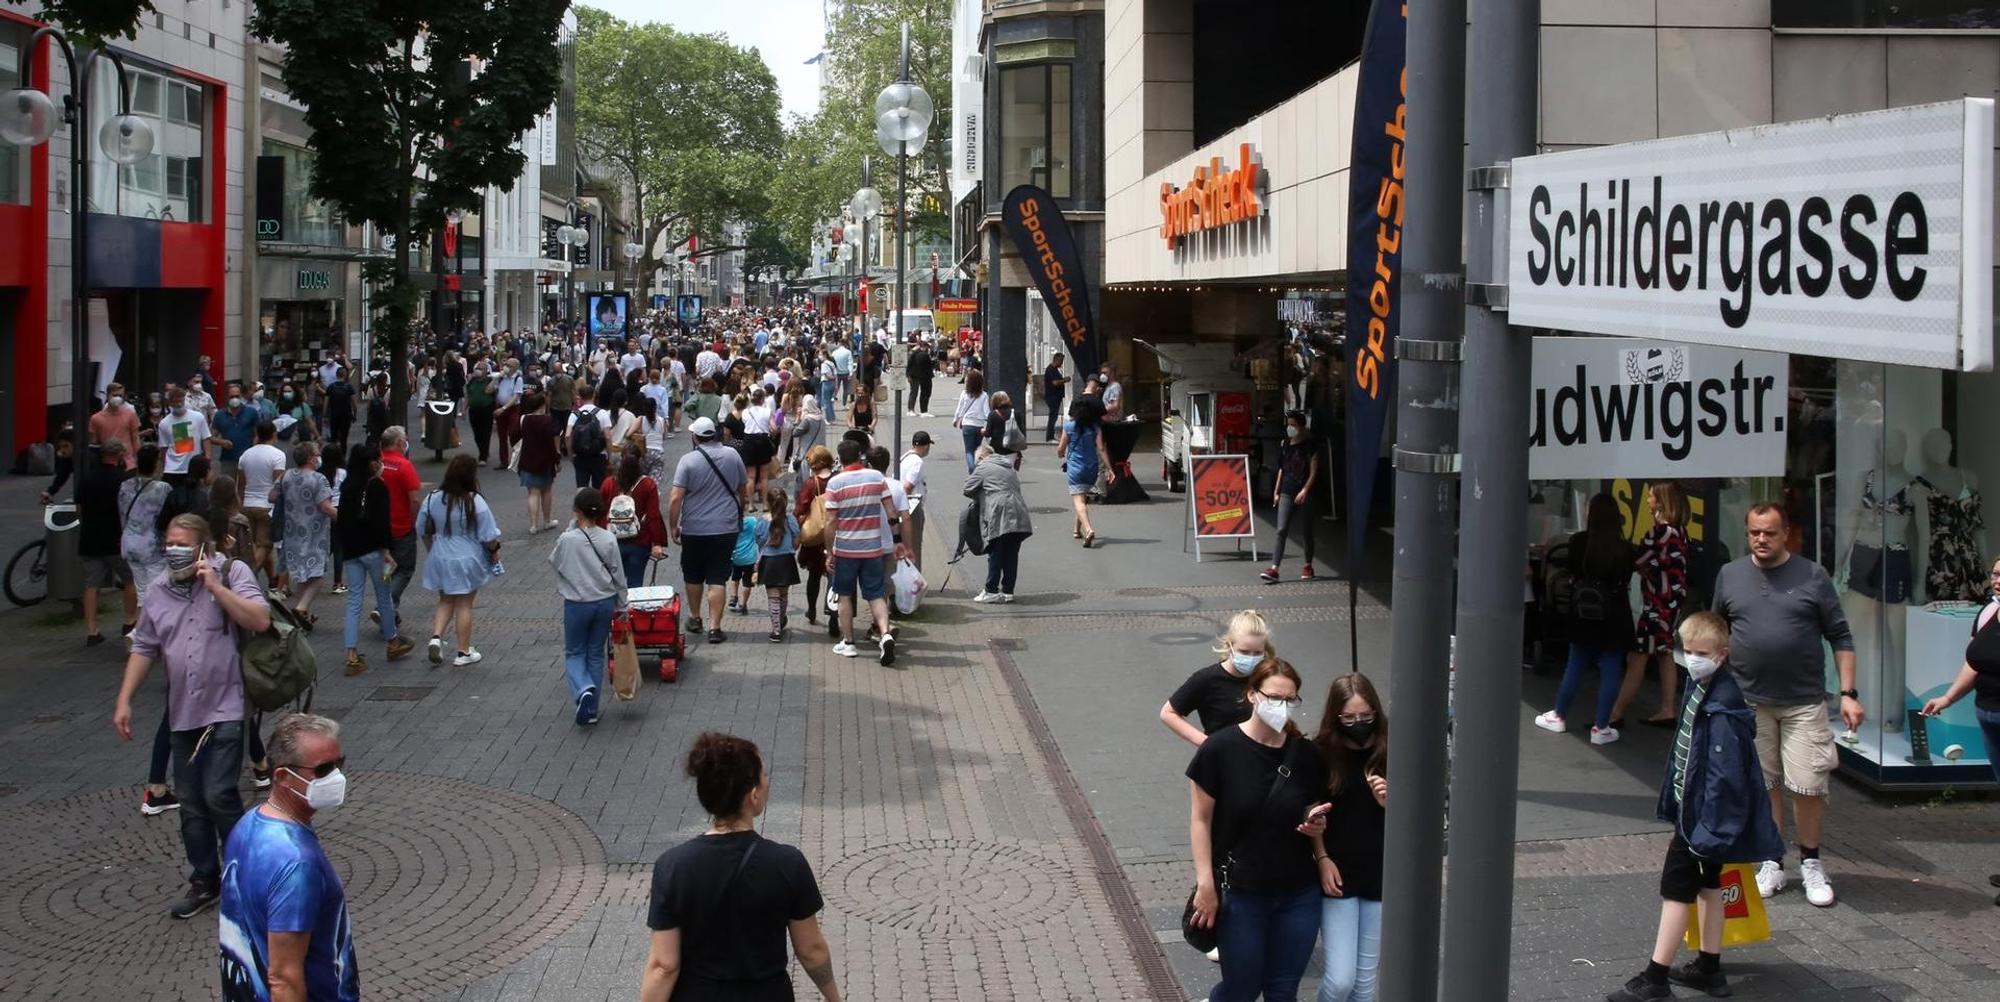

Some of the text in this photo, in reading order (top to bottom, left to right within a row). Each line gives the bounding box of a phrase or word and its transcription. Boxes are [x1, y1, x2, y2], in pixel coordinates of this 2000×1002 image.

[1160, 143, 1262, 250] SportScheck
[299, 269, 331, 289] DOUGLAS
[1019, 198, 1086, 347] SportScheck
[1527, 175, 1929, 329] Schildergasse
[1529, 359, 1784, 461] udwigstr.
[1612, 477, 1704, 545] SAE
[1721, 884, 1741, 905] GO
